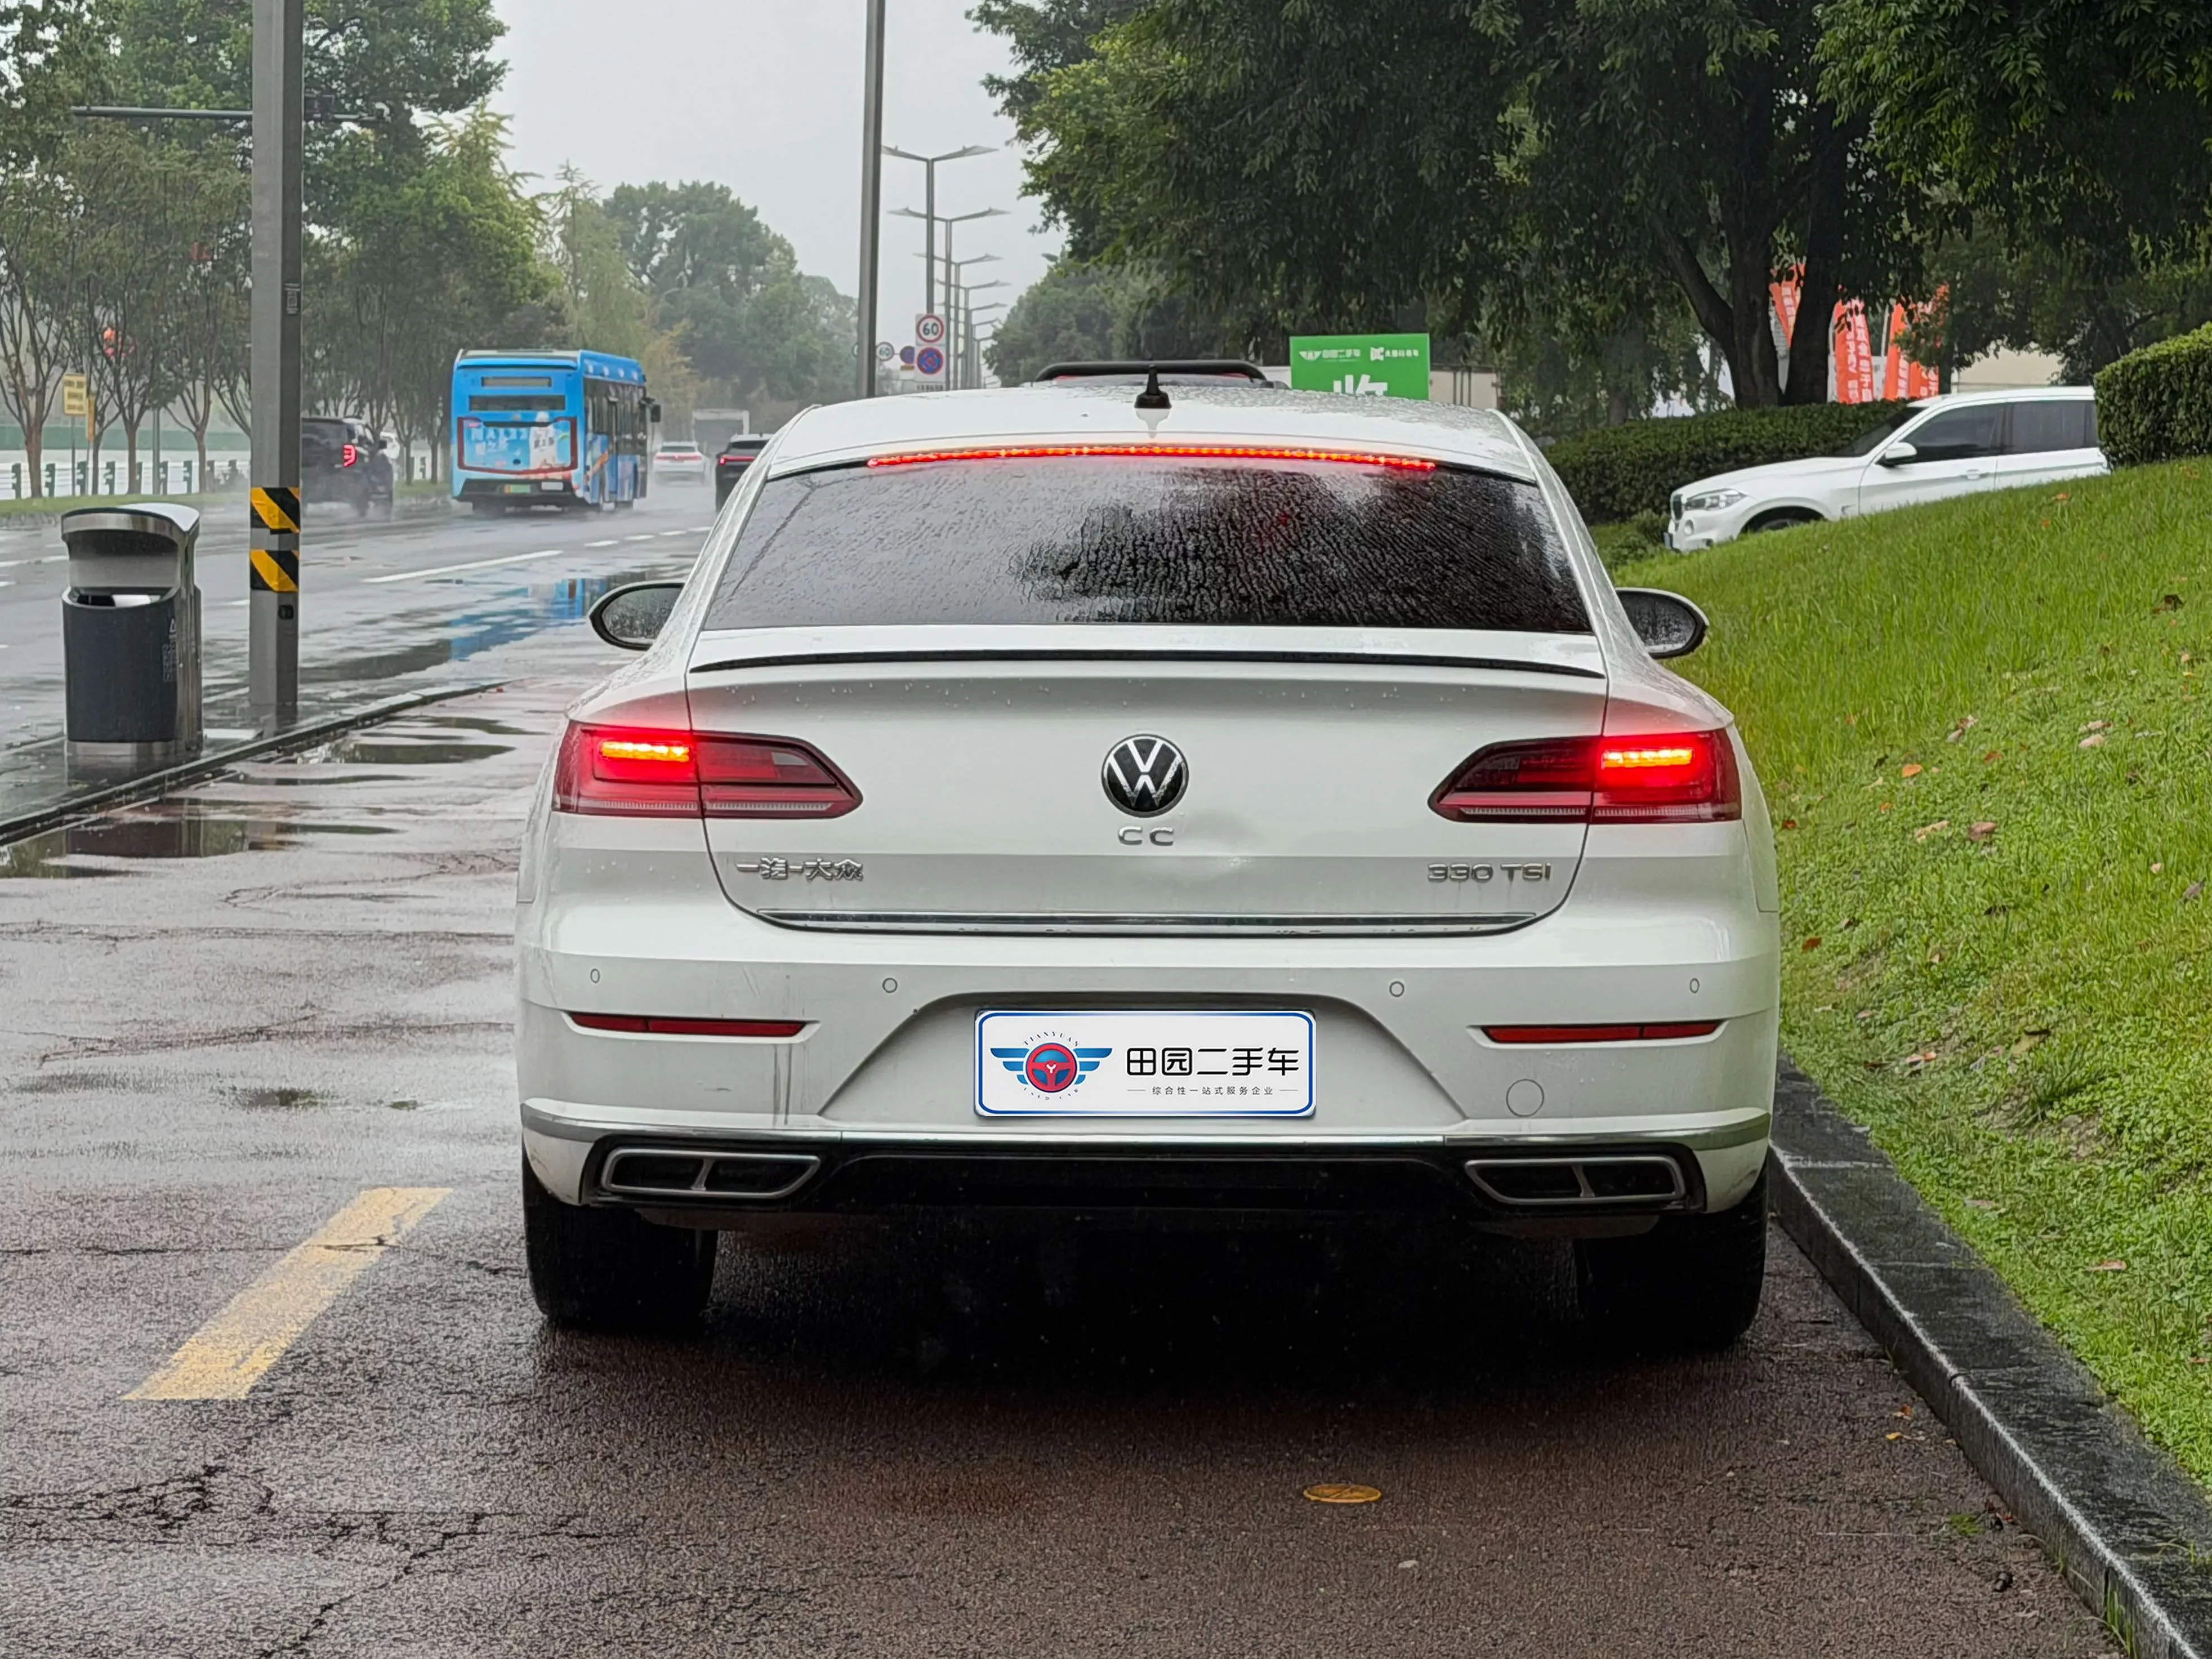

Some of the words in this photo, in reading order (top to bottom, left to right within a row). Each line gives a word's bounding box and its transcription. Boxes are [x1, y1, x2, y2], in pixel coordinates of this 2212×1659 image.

[922, 322, 939, 336] 60
[1104, 737, 1187, 812] VW
[1118, 826, 1174, 846] CC
[1428, 863, 1494, 883] 330
[1500, 862, 1551, 882] TSI
